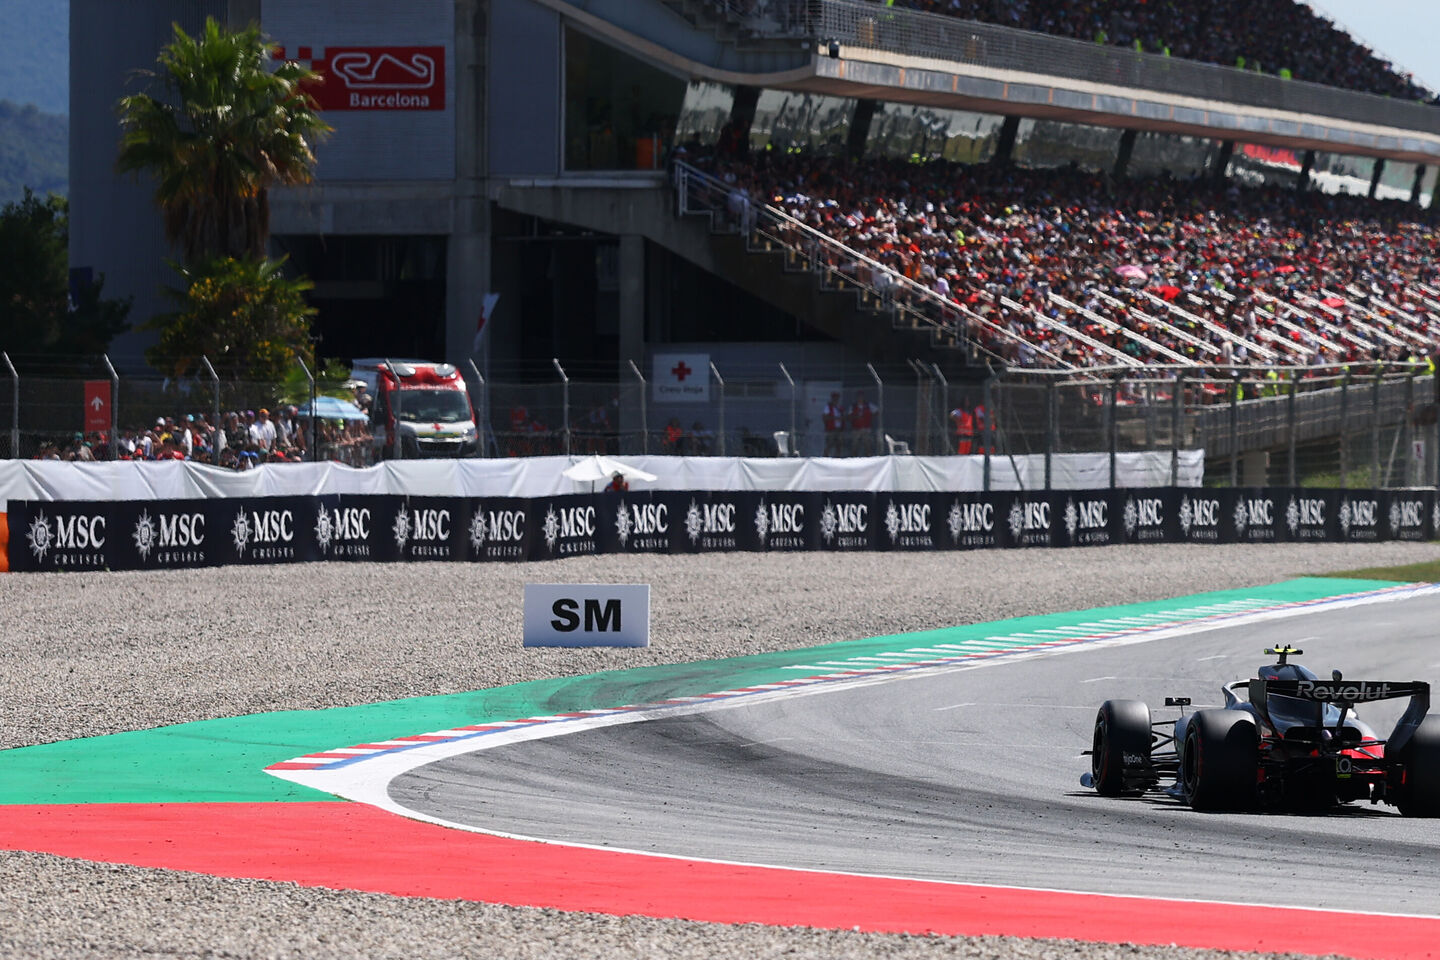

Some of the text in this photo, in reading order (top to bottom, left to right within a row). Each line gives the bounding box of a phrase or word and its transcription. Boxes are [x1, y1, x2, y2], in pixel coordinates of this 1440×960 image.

[350, 92, 430, 107] Barcelona
[253, 510, 294, 542] MSC
[334, 508, 371, 539] MSC
[413, 509, 450, 540] MSC
[489, 510, 525, 541] MSC
[560, 506, 596, 537] MSC
[632, 503, 668, 534] MSC
[703, 503, 736, 533] MSC
[770, 503, 804, 533] MSC
[837, 504, 868, 533] MSC
[900, 503, 931, 533] MSC
[962, 503, 994, 532] MSC
[1024, 502, 1050, 530] MSC
[1079, 500, 1108, 528] MSC
[1137, 499, 1163, 526] MSC
[55, 515, 106, 549] MSC
[159, 513, 205, 547] MSC
[55, 554, 105, 565] CRUISES
[551, 598, 621, 632] SM
[1297, 681, 1391, 700] Revolut
